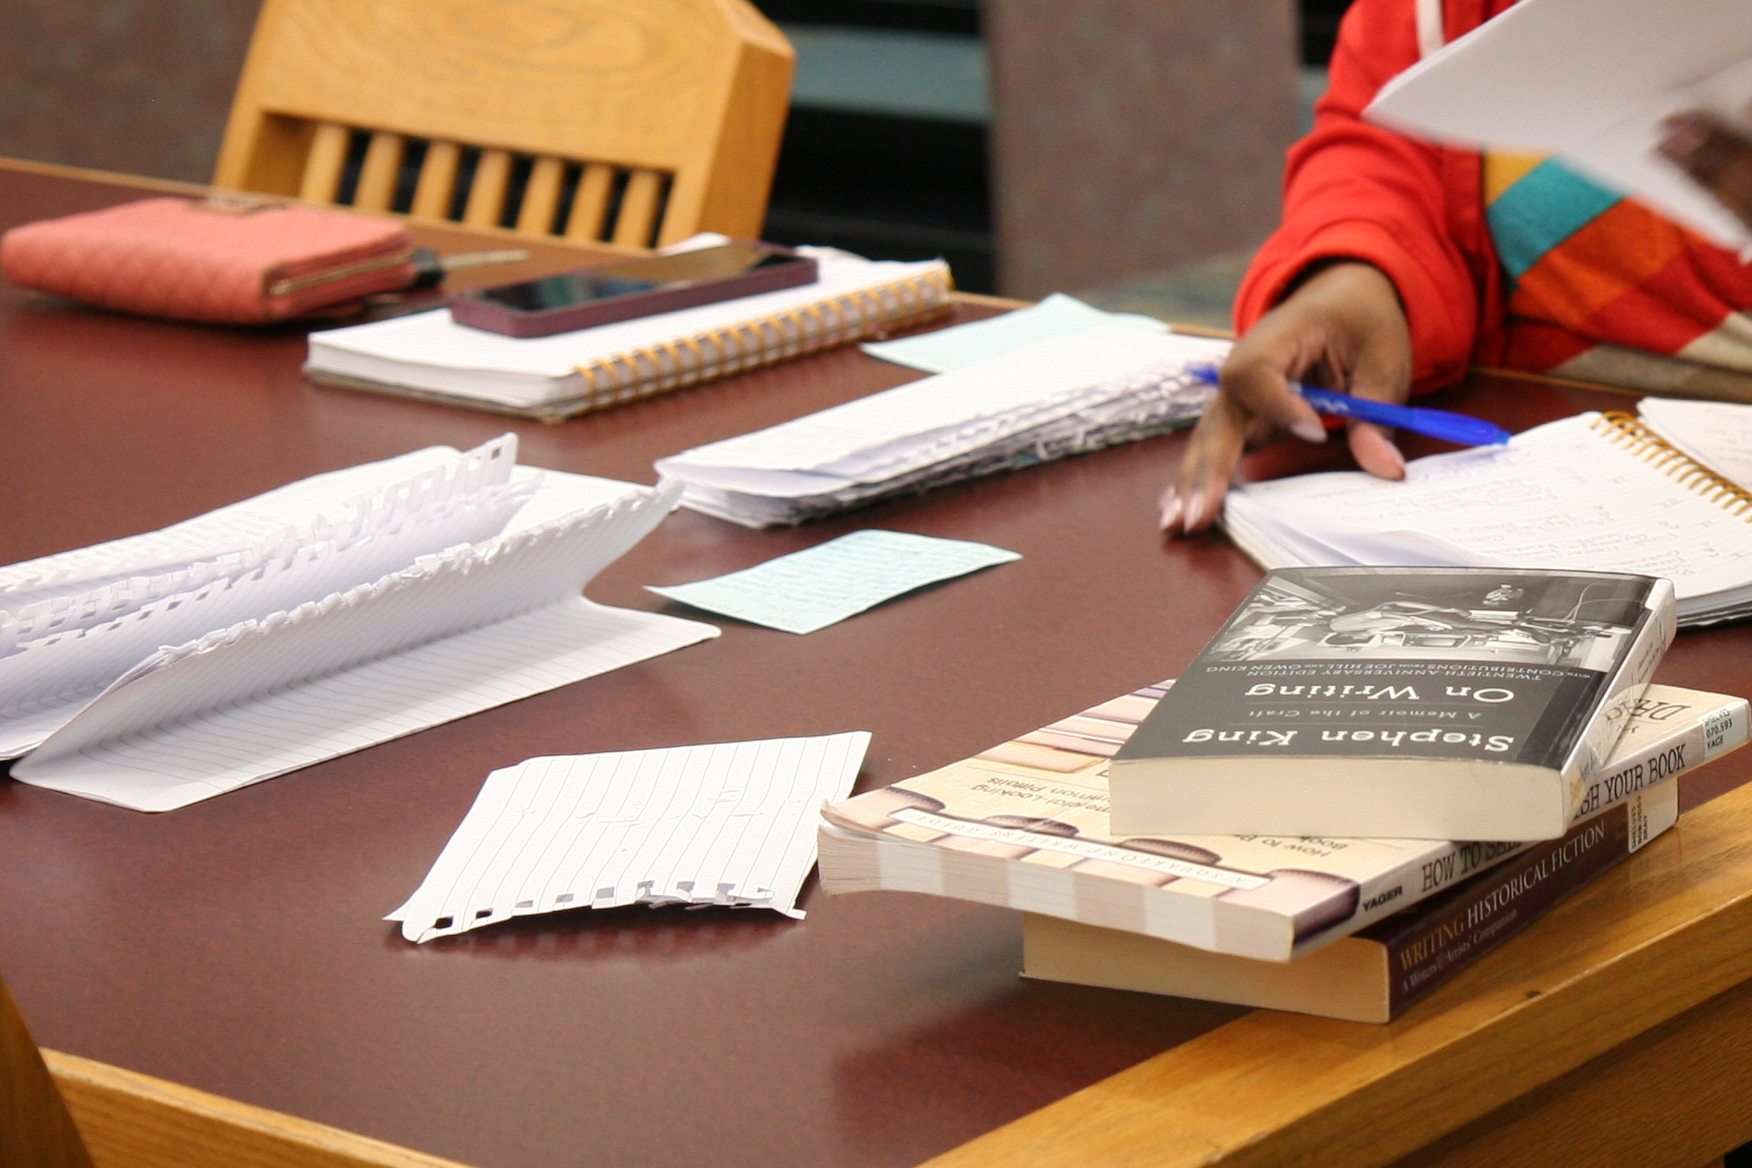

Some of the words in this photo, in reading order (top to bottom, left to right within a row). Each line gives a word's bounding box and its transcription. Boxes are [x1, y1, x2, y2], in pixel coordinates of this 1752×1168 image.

[1205, 664, 1248, 673] KING
[1246, 669, 1317, 677] EDITION
[1250, 663, 1302, 671] OWEN
[1426, 663, 1564, 677] CONTRIBUTIONS
[1244, 683, 1421, 700] Writing
[1445, 685, 1515, 703] On
[1248, 708, 1301, 719] Craft
[1310, 708, 1342, 718] the
[1350, 709, 1371, 719] of
[1378, 709, 1457, 720] Memoir
[1466, 711, 1483, 720] A
[1182, 728, 1299, 746] King
[1321, 729, 1515, 752] Stephen
[986, 778, 1047, 792] Pitfalls
[1421, 849, 1457, 892] HOW
[1459, 841, 1481, 876] TO
[1604, 763, 1645, 805] YOUR
[1648, 743, 1687, 785] BOOK
[1261, 838, 1282, 848] to
[1283, 843, 1332, 857] How
[1362, 885, 1403, 912] YAGER
[1399, 911, 1464, 970] WRITING
[1467, 858, 1549, 929] HISTORICAL
[1550, 819, 1606, 873] FICTION
[1472, 908, 1518, 945] Companion
